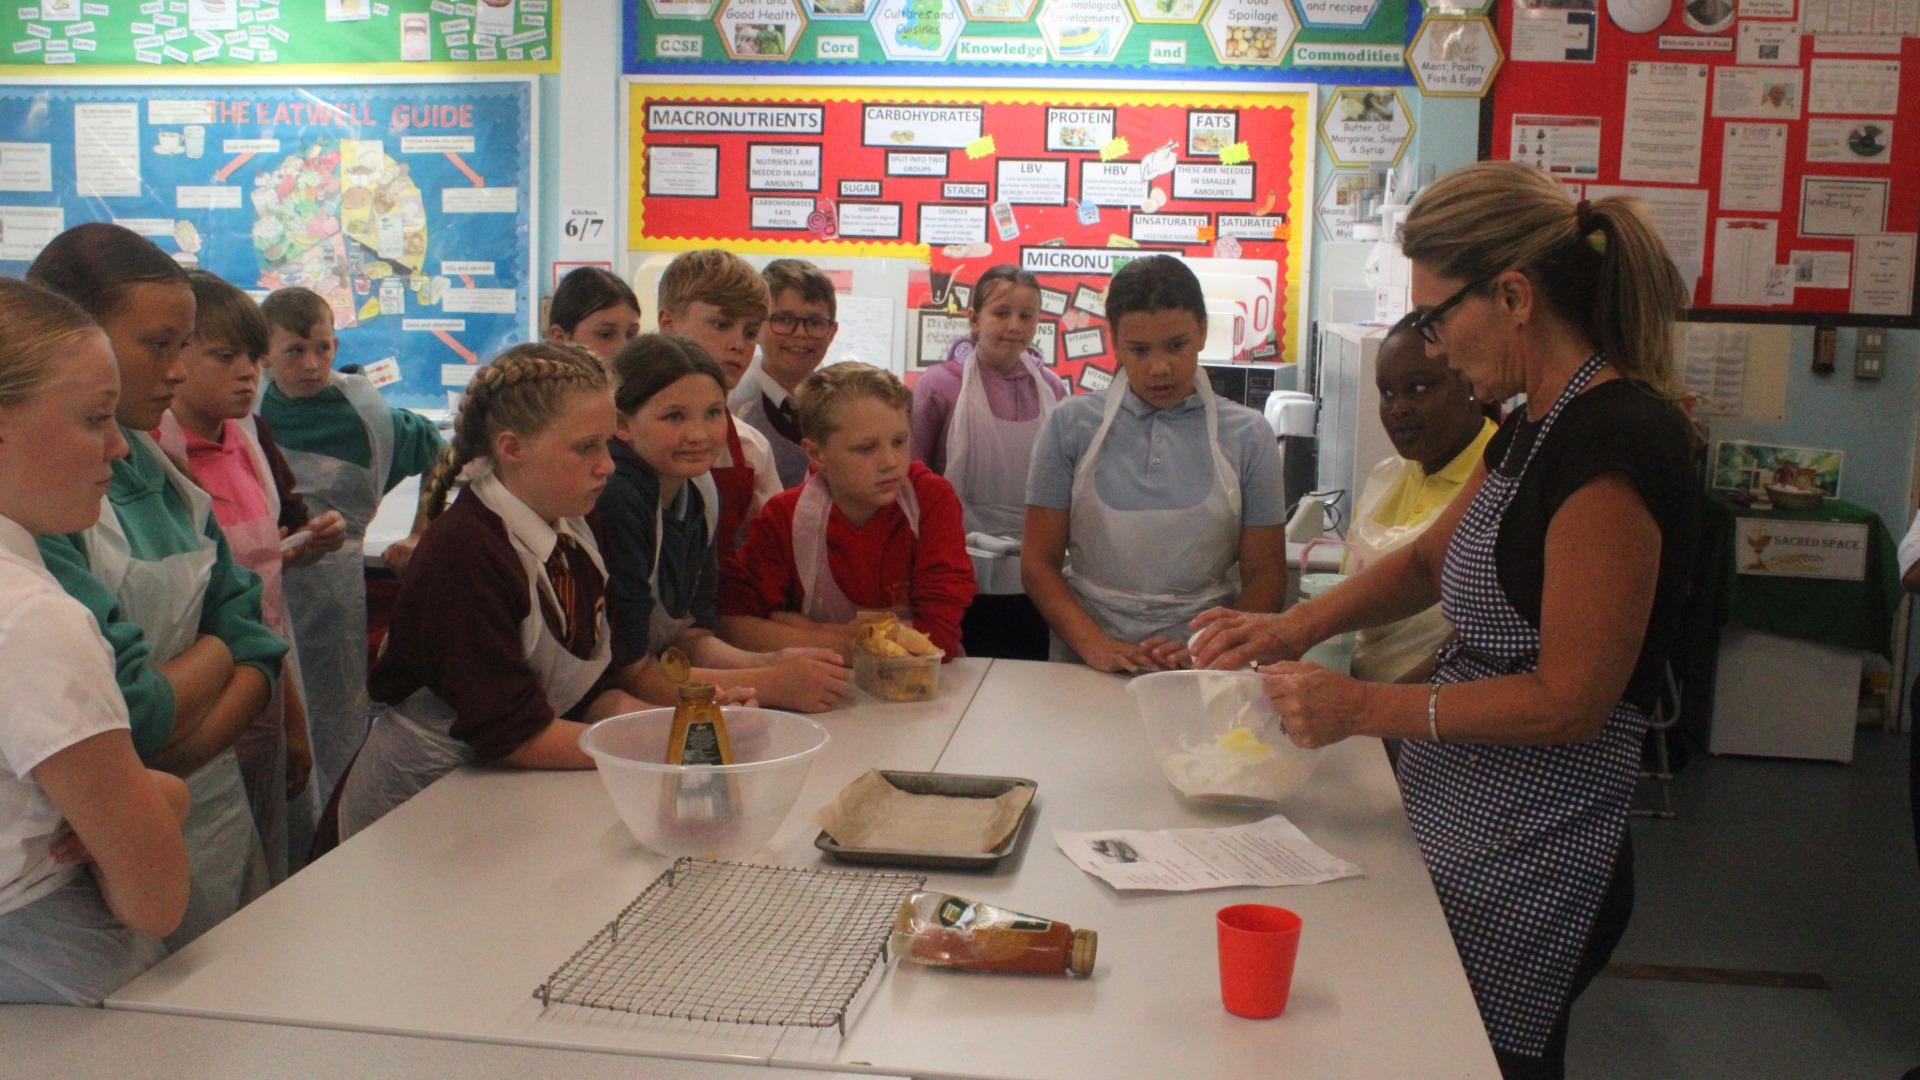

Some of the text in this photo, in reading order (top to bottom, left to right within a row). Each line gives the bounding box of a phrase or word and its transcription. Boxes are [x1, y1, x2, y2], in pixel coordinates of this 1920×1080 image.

[1306, 2, 1368, 14] and recipes
[726, 8, 797, 21] Good Health
[883, 8, 954, 21] Cultures and
[1228, 8, 1279, 24] Spoilage
[896, 23, 940, 35] Cuisines
[660, 39, 699, 52] GCSE
[821, 41, 855, 54] Core
[960, 42, 1043, 58] Knowledge
[1153, 46, 1182, 58] and
[1297, 48, 1400, 63] Commodities
[1422, 62, 1488, 74] Meat, Poultry,
[1427, 74, 1482, 86] Fish & Eggs
[206, 101, 251, 124] THE
[257, 102, 376, 126] EATWELL
[392, 104, 474, 128] GUIDE
[653, 110, 818, 128] MACRONUTRIENTS
[867, 108, 980, 122] CARBOHYDRATES
[1050, 112, 1111, 124] PROTEIN
[1196, 116, 1231, 128] FATS
[1344, 123, 1393, 134] Butter, Oil,
[1331, 135, 1406, 146] Margarine, Sugar
[770, 147, 791, 155] THESE
[1359, 146, 1385, 156] Syrup
[756, 158, 813, 167] NUTRIENTS ARE
[909, 156, 926, 164] INTO
[752, 169, 782, 177] NEEDED
[793, 170, 817, 178] LARGE
[1020, 163, 1042, 173] LBV
[1103, 165, 1128, 175] HBV
[1178, 166, 1200, 175] THESE
[1203, 167, 1217, 175] ARE
[765, 180, 804, 188] AMOUNTS
[843, 184, 877, 193] SUGAR
[946, 186, 985, 196] STARCH
[755, 199, 812, 208] CARBOHYDRATES
[1321, 207, 1348, 217] Beans,
[768, 218, 797, 226] PROTEIN
[1135, 216, 1205, 227] UNSATURATED
[1221, 218, 1280, 228] SATURATED
[565, 218, 604, 241] 6/7
[1068, 331, 1098, 342] VITAMIN
[1082, 344, 1088, 353] C
[1774, 536, 1860, 550] SACRED SPACE
